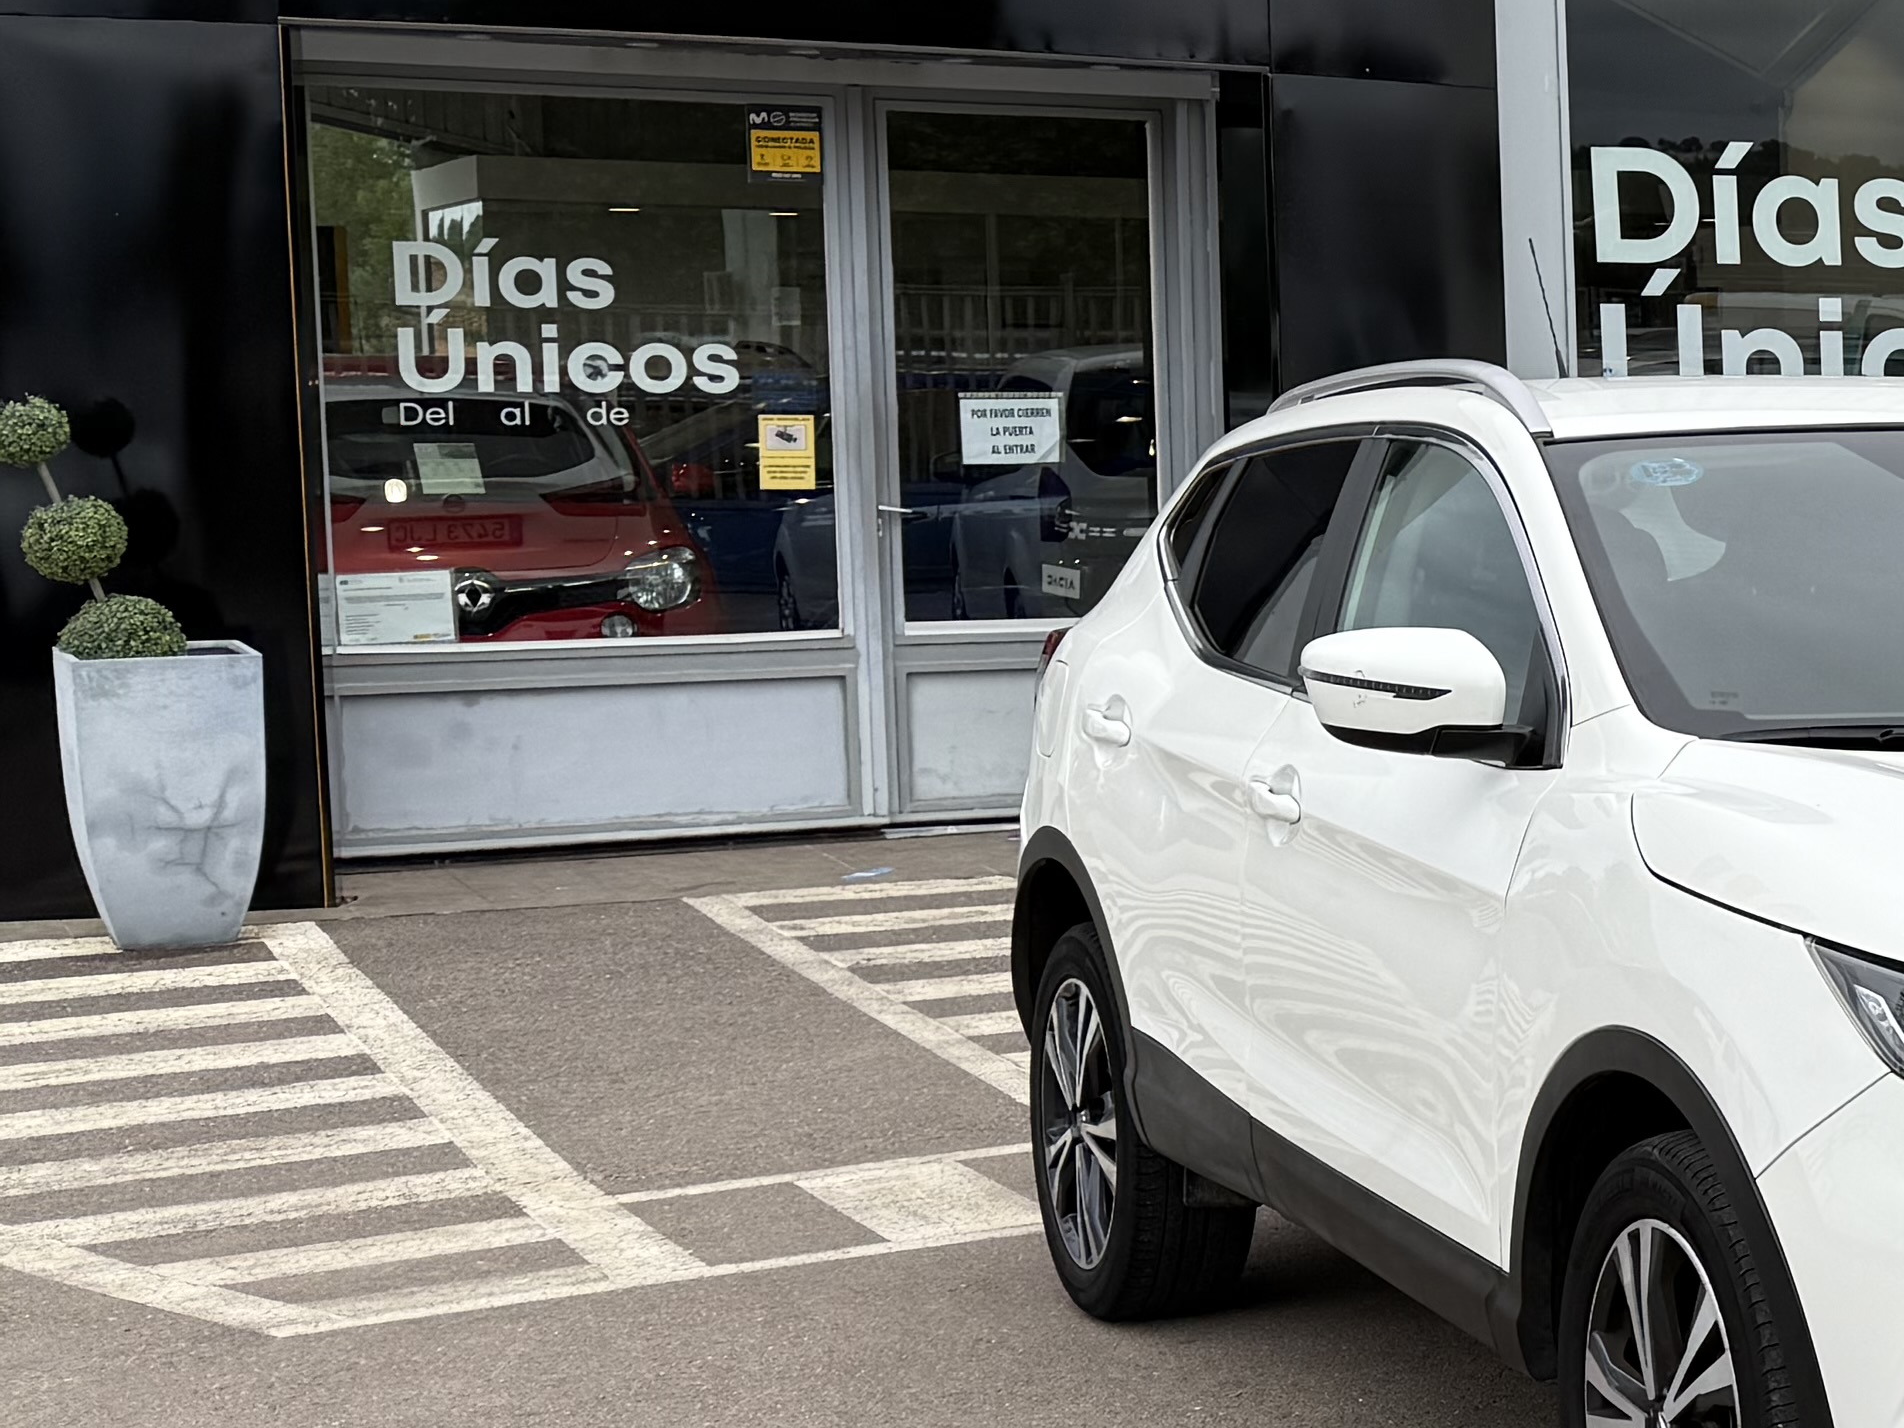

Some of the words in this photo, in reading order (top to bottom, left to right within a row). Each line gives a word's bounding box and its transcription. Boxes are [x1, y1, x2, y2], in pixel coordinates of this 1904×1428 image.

[392, 237, 615, 310] Días
[397, 308, 740, 394] Únicos
[399, 400, 455, 427] Del
[500, 401, 531, 426] al
[586, 401, 630, 426] de
[971, 409, 988, 419] POR
[990, 408, 1015, 418] FAVOR
[990, 426, 1001, 436] LA
[1003, 426, 1034, 436] PUERTA
[991, 445, 1001, 455] AL
[1004, 444, 1036, 454] ENTRAR
